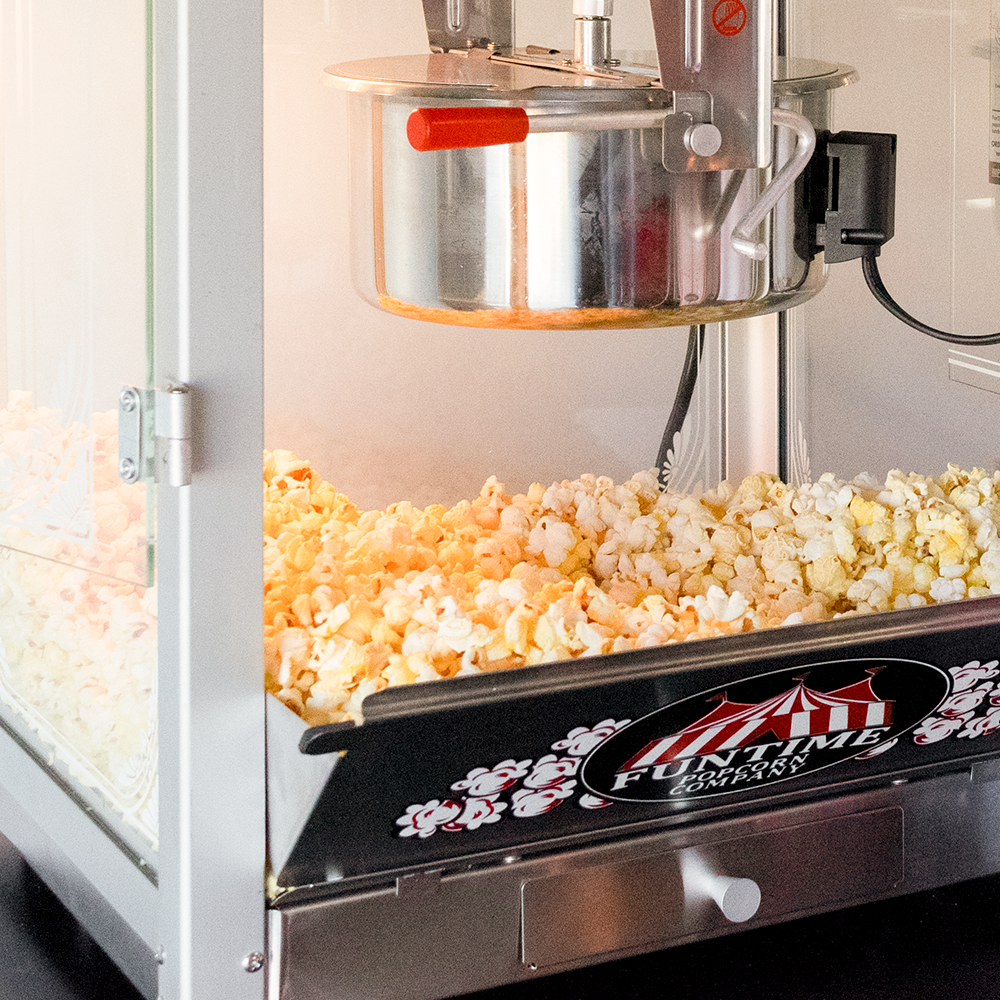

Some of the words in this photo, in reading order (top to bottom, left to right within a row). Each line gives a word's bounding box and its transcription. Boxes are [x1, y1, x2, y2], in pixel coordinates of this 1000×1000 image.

[611, 726, 891, 791] FUNTIME
[678, 753, 811, 785] POPCORN
[669, 763, 806, 796] COMPANY
